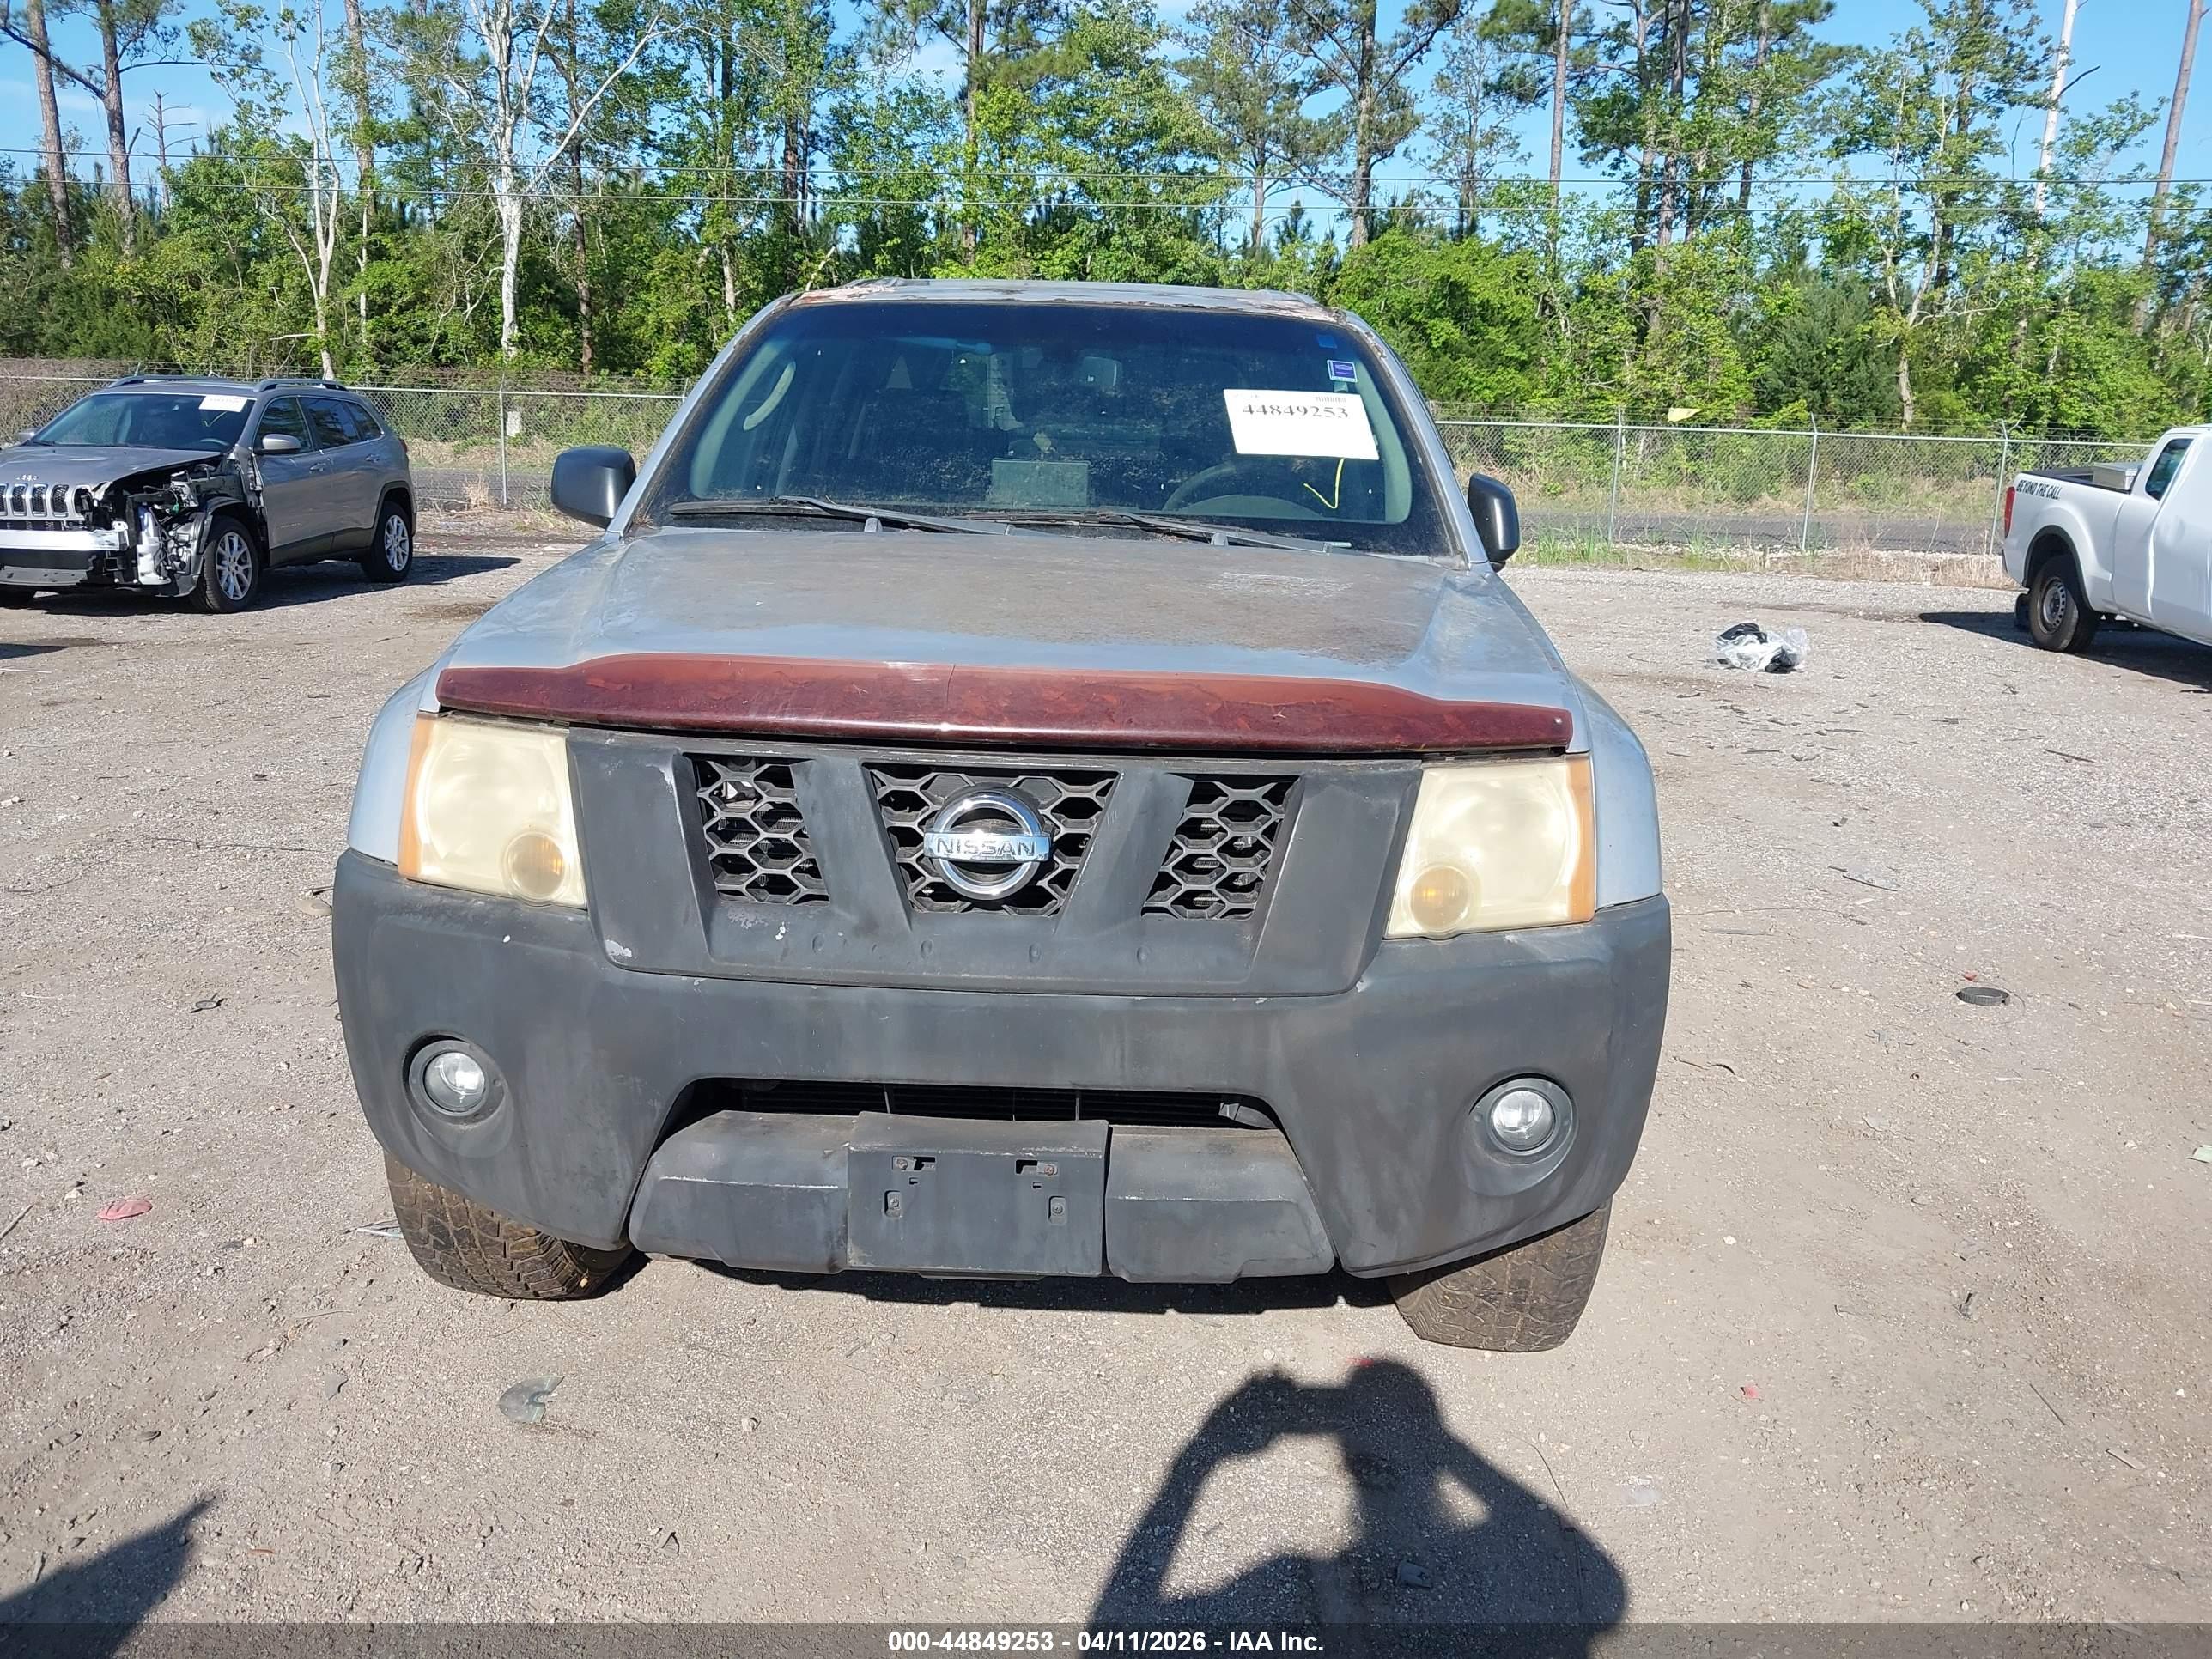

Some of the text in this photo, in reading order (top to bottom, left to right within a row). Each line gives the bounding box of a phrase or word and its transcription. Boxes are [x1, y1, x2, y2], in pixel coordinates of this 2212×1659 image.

[1243, 404, 1349, 418] 44849253
[2016, 480, 2038, 495] BEYOND
[2035, 483, 2049, 497] THE
[938, 838, 1035, 856] NISSAN
